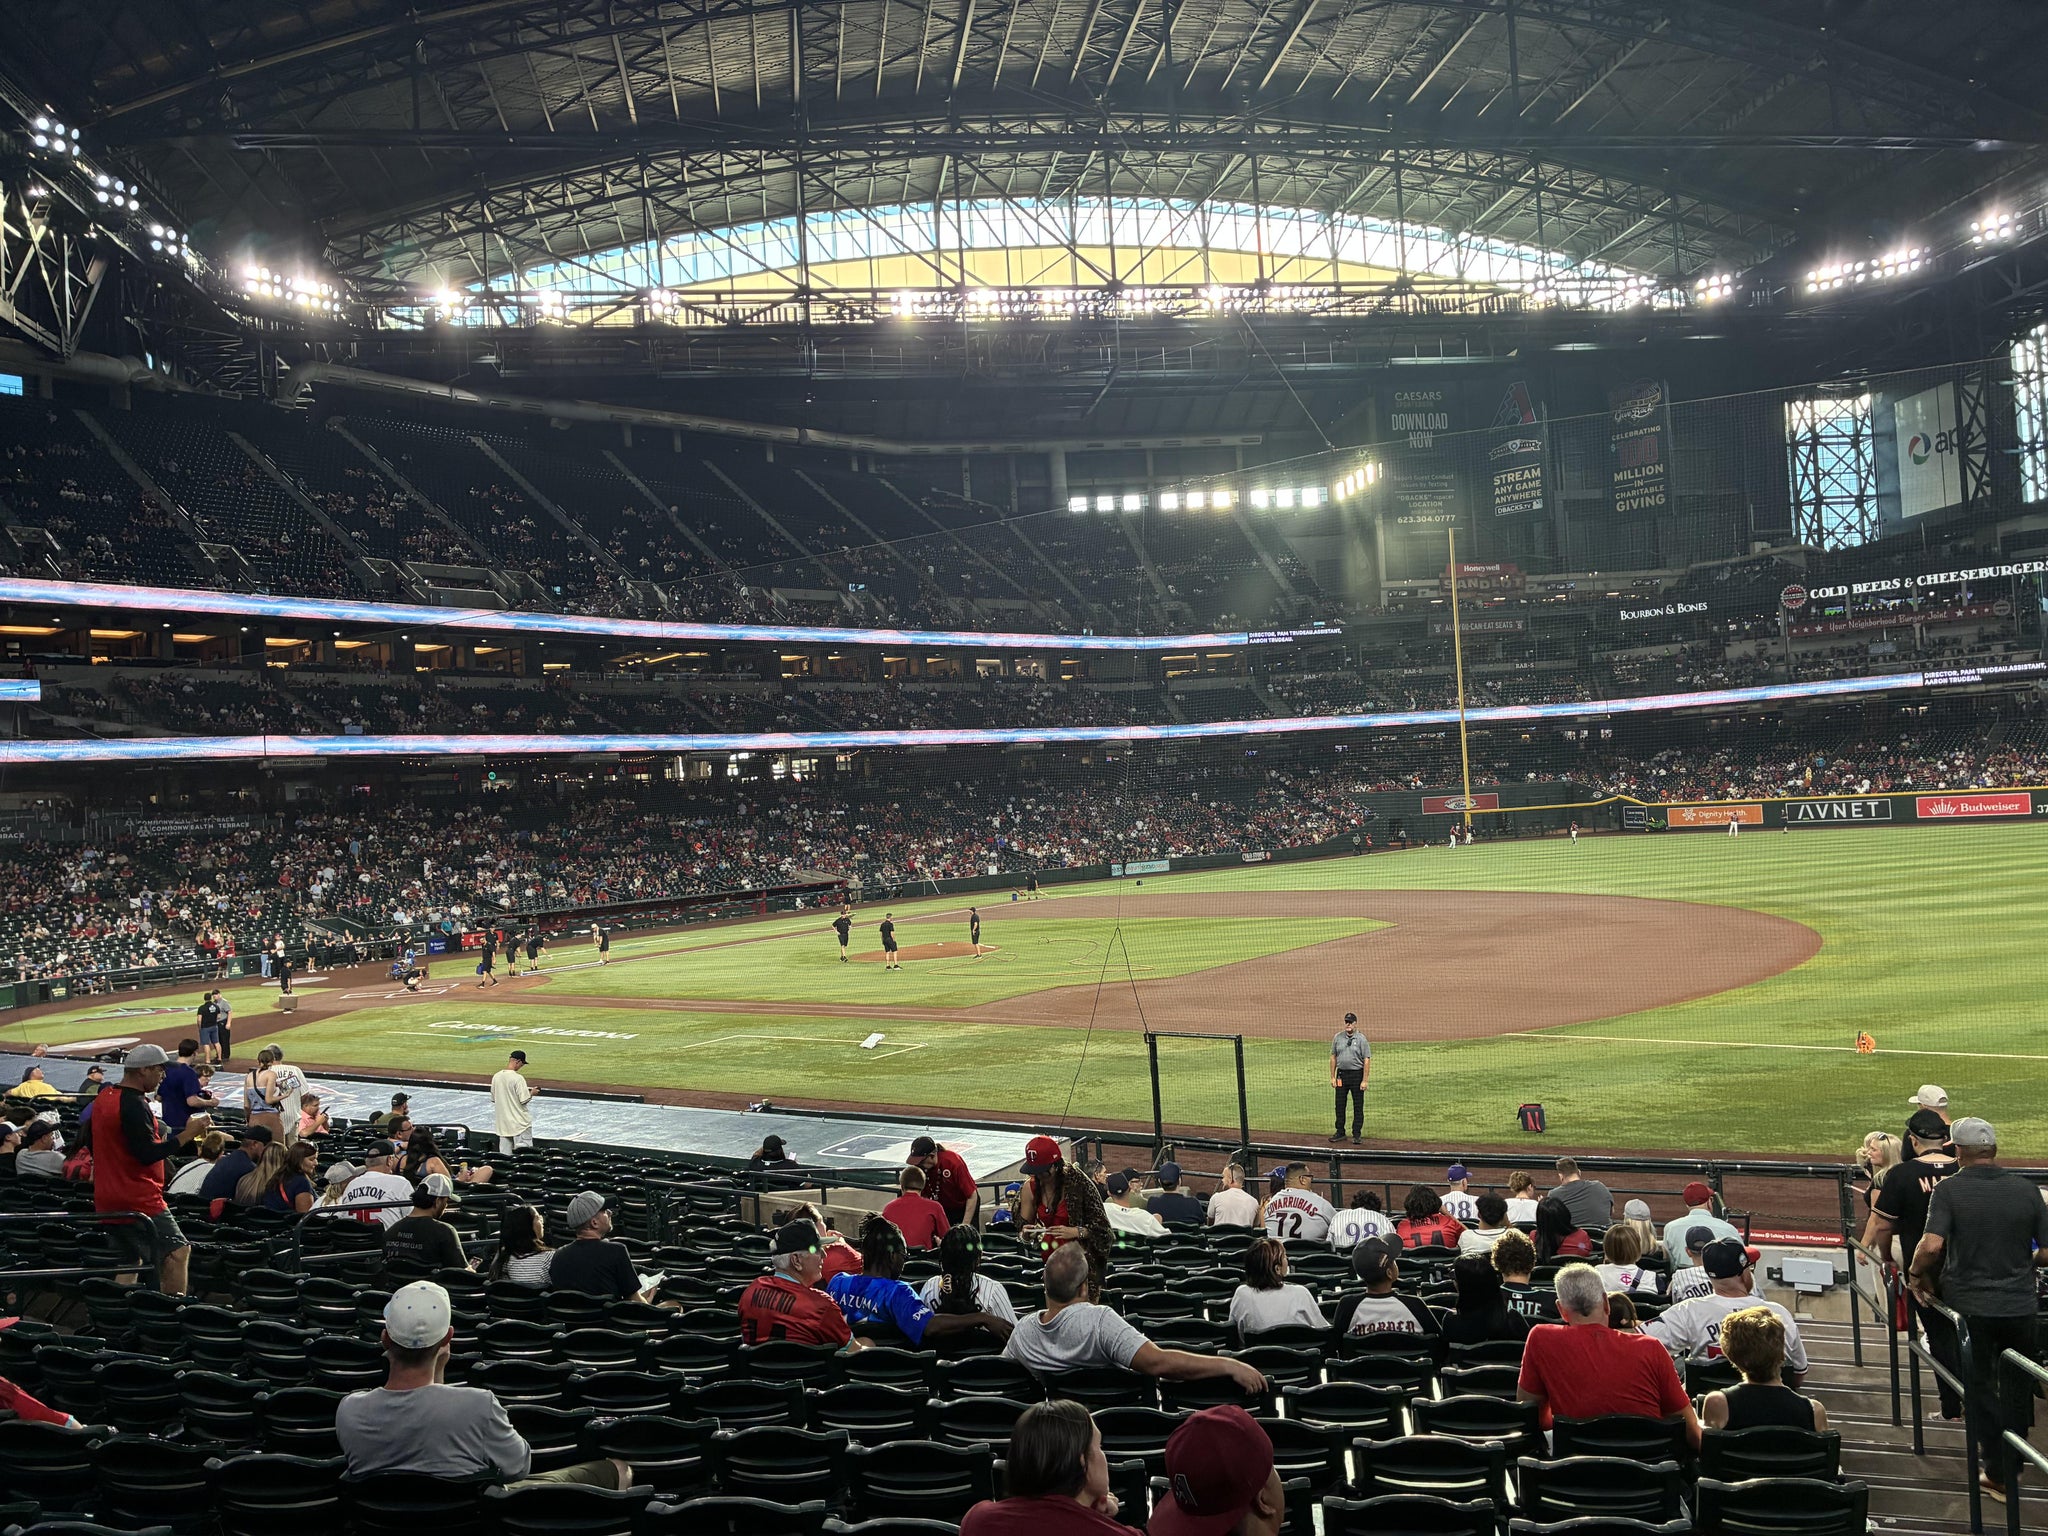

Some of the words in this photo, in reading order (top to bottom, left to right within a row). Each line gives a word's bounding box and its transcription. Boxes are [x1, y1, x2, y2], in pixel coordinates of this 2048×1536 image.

[1394, 391, 1442, 401] CAESARS
[1392, 412, 1448, 431] DOWNLOAD
[1409, 431, 1433, 448] NOW
[1611, 425, 1661, 441] CELEBRATING
[1494, 467, 1541, 486] STREAM
[1614, 464, 1664, 482] MILLION
[1494, 484, 1512, 496] ANY
[1516, 480, 1542, 490] GAME
[1634, 478, 1644, 487] IN
[1495, 489, 1542, 504] ANYWHERE
[1616, 485, 1664, 500] CHARITABLE
[1616, 494, 1666, 512] GIVING
[1397, 514, 1456, 524] 623.304.0777
[1464, 564, 1500, 573] Honeywell
[1810, 585, 1848, 600] COLD
[1852, 578, 1900, 594] BEERS
[1904, 578, 1914, 588] &
[1666, 604, 1676, 614] &
[1496, 620, 1513, 629] SEATS
[1829, 622, 1847, 631] Your
[1848, 616, 1897, 630] Neighborhood
[1898, 614, 1925, 624] Burger
[1927, 611, 1948, 620] Joint
[1698, 810, 1722, 819] Dignity
[1798, 802, 1879, 820] AVNET
[1960, 801, 2020, 813] Budweiser
[151, 824, 214, 832] COMMONWEALTH
[348, 1186, 386, 1202] BUXTON
[1275, 1212, 1302, 1238] 72
[1346, 1222, 1379, 1246] 98
[752, 1288, 796, 1314] MORENO
